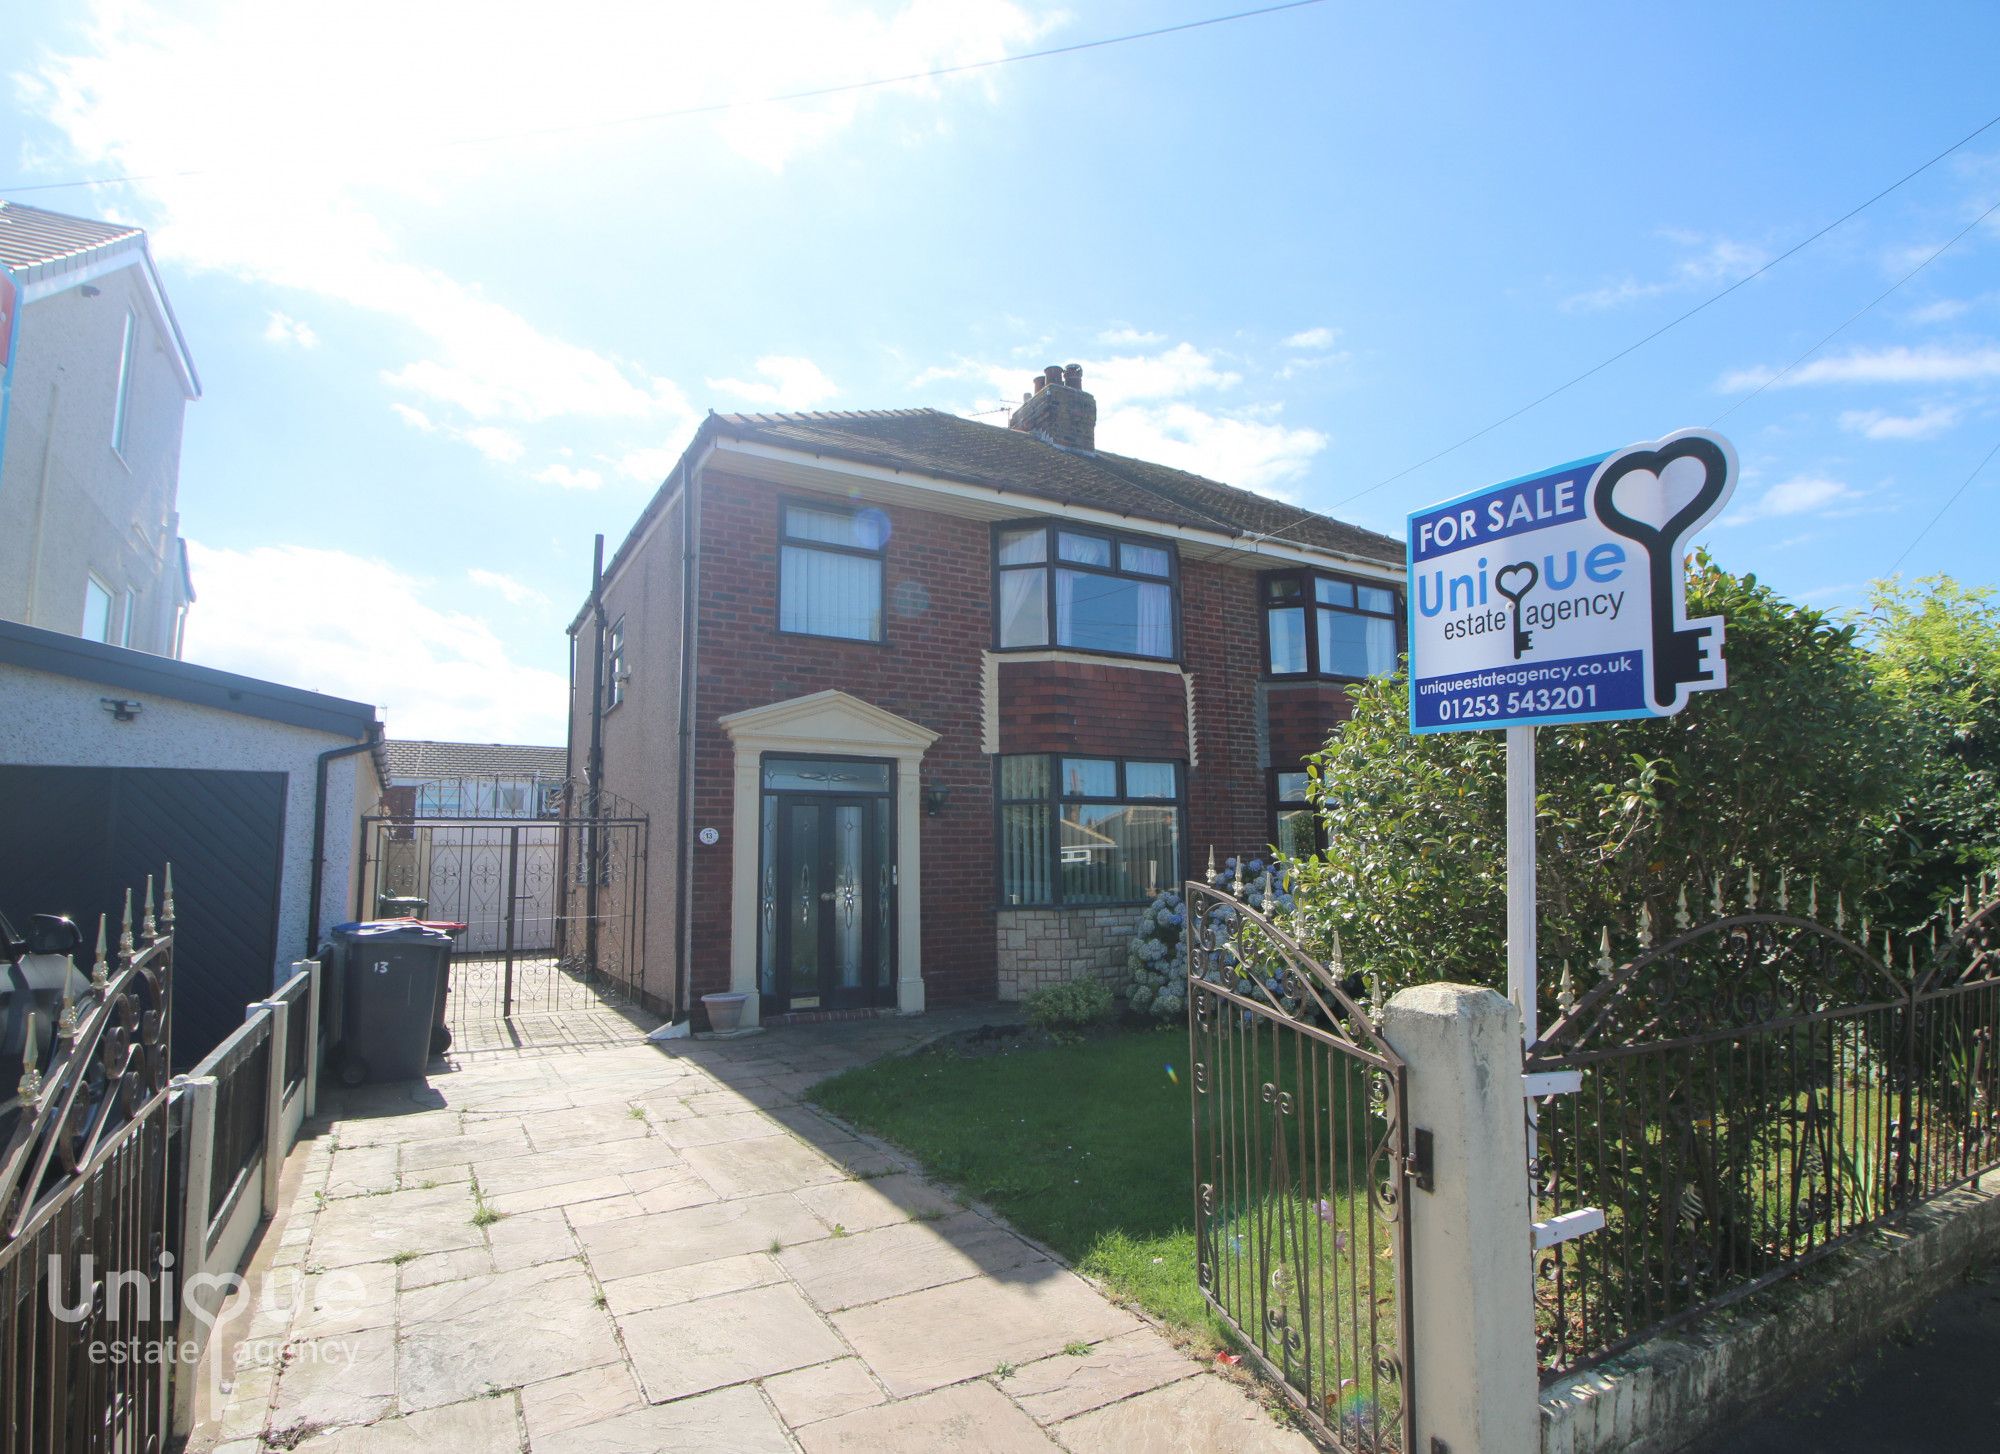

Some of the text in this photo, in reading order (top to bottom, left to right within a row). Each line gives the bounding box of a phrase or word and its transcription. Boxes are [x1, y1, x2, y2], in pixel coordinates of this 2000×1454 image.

[1420, 481, 1575, 552] FOR SALE
[1444, 591, 1625, 640] estate agency
[1420, 656, 1632, 695] uniqueestateagency.co.uk
[1439, 685, 1597, 721] 01253 543201
[373, 961, 389, 973] 13
